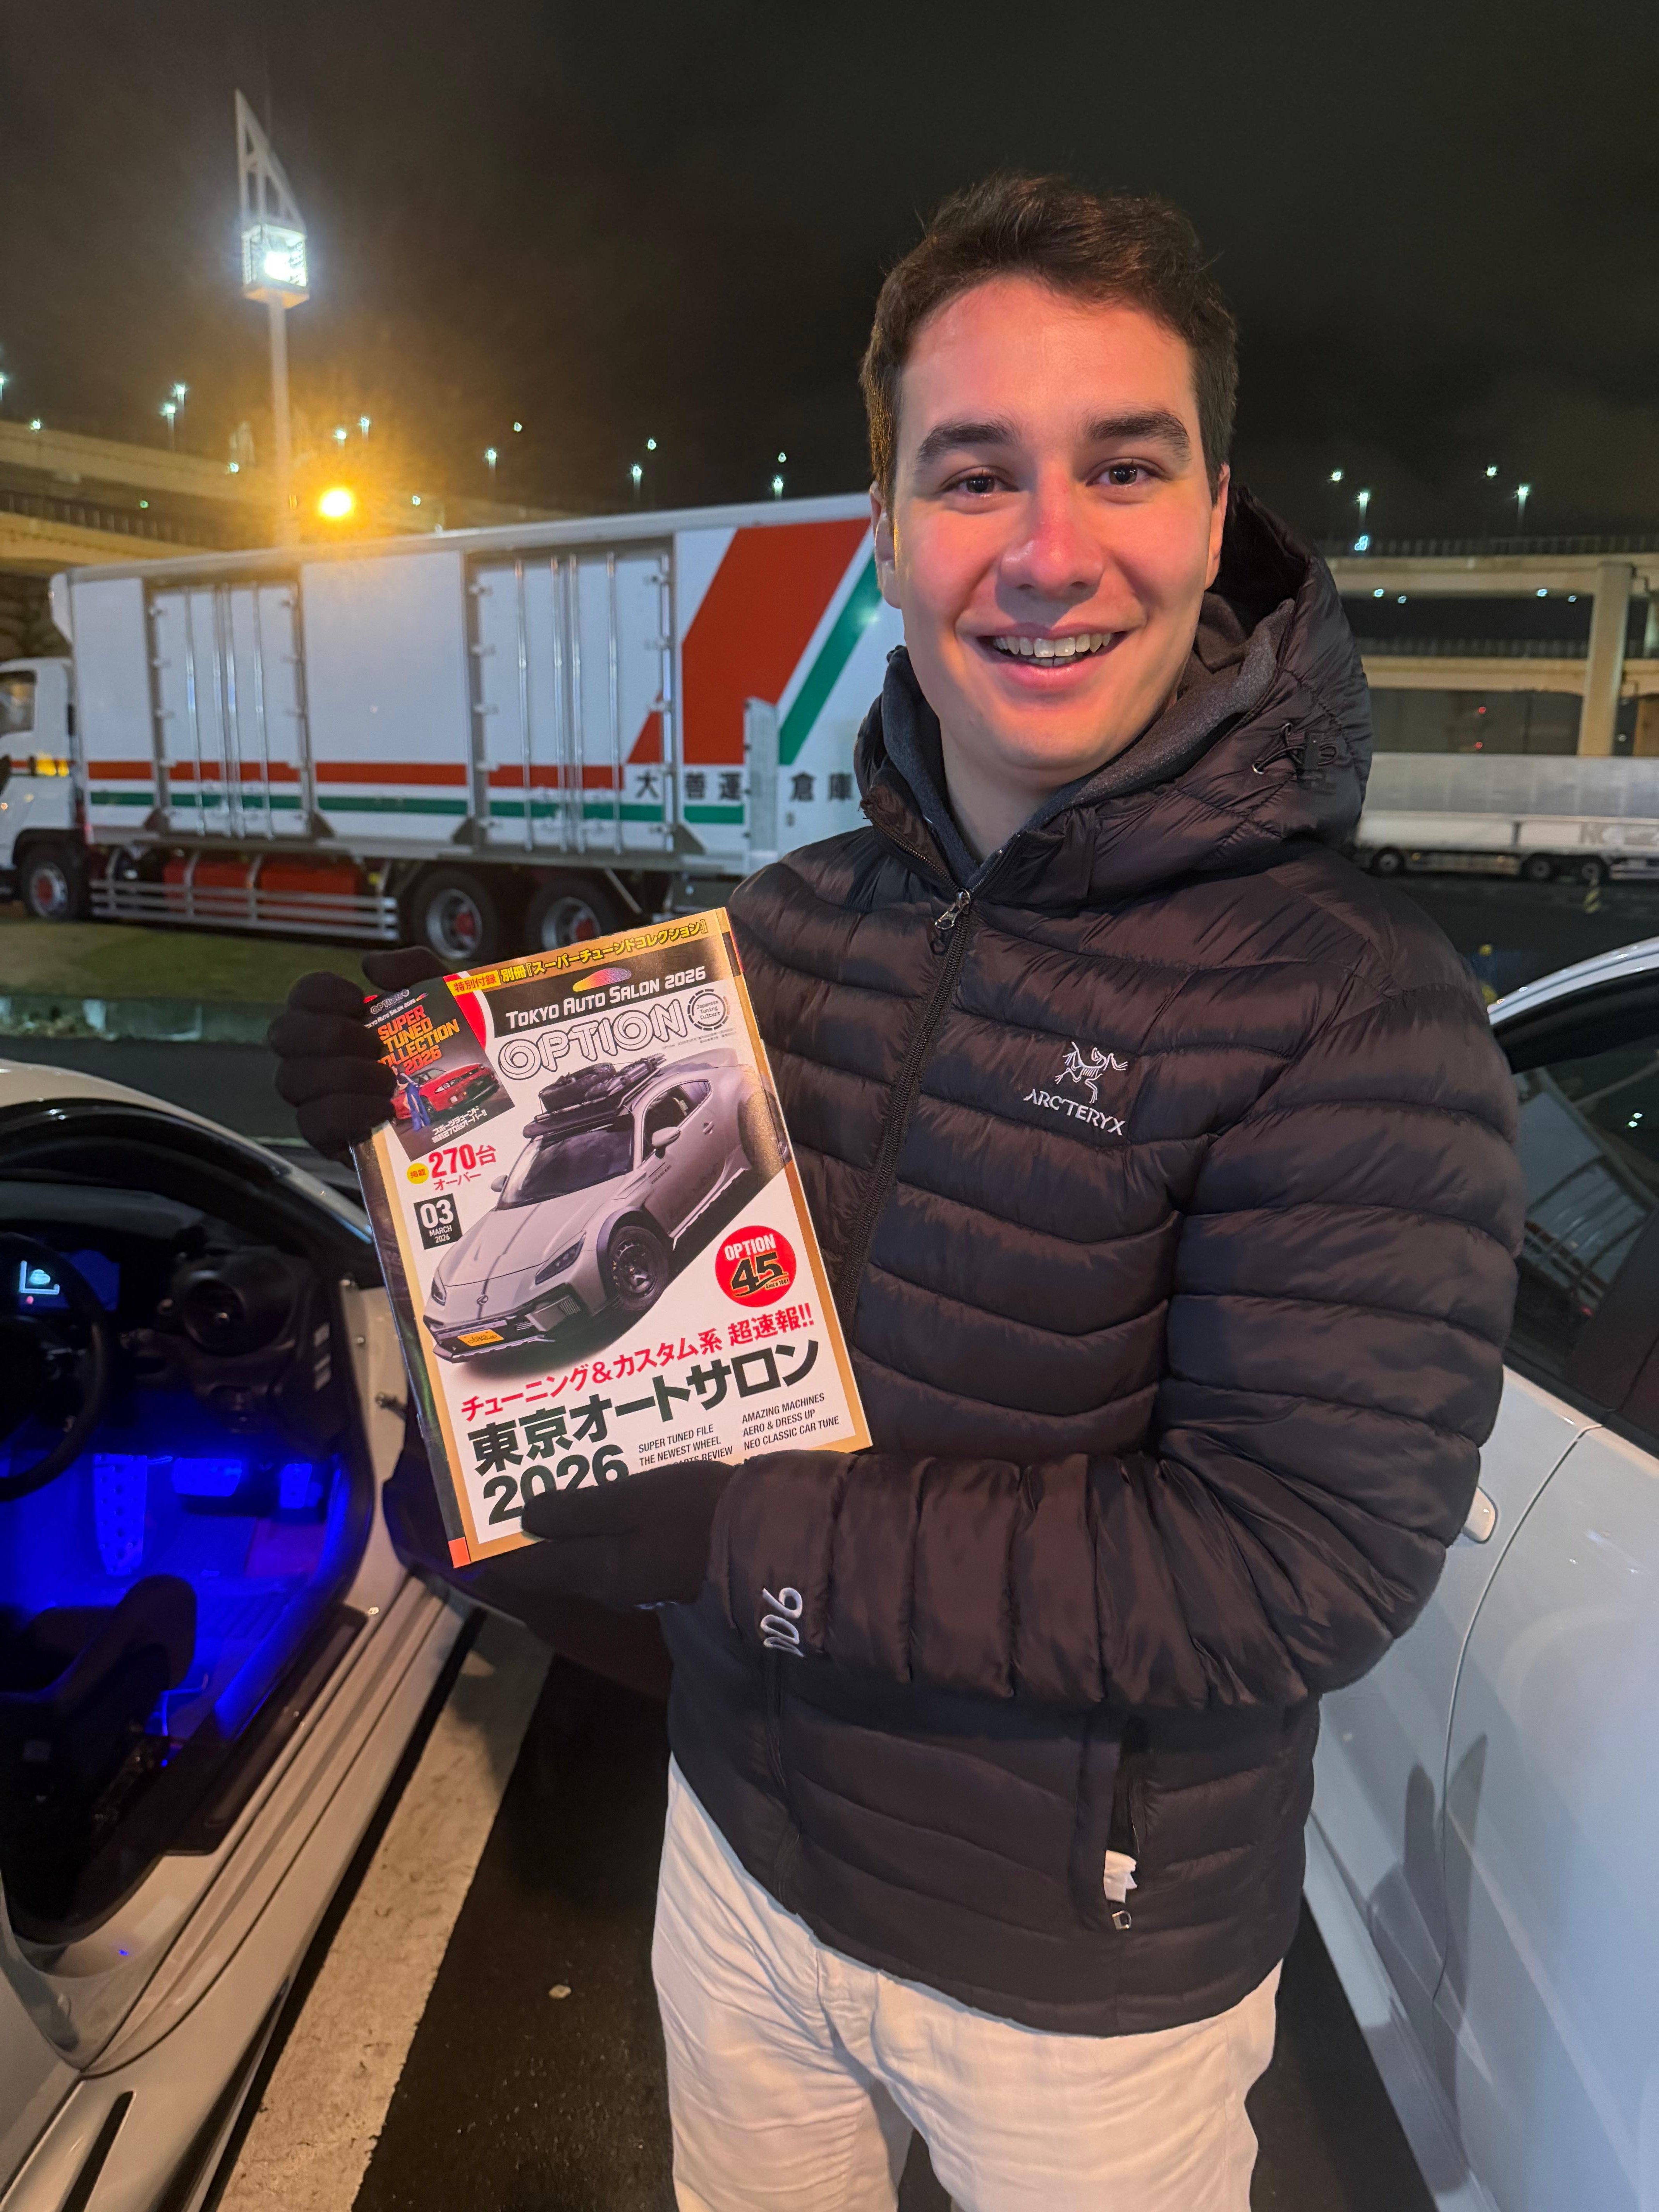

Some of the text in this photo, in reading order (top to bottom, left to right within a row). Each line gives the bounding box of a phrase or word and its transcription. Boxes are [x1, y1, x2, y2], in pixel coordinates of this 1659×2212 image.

[454, 975, 497, 992] 特別付録
[506, 966, 706, 1029] TOKYO AUTO SALON 2026
[697, 1000, 719, 1009] Japanese
[700, 1006, 718, 1014] Tuning
[700, 1011, 721, 1020] Culture
[378, 1005, 426, 1041] SUPER
[383, 1017, 433, 1052] TUNED
[377, 1018, 460, 1068] OLLECTION
[498, 999, 688, 1080] OPTION
[403, 1045, 442, 1075] 2026
[429, 1144, 496, 1178] 270台
[434, 1171, 481, 1190] オーバー
[420, 1199, 453, 1228] 03
[429, 1225, 452, 1237] MARCH
[434, 1234, 450, 1243] 2026
[724, 1233, 776, 1261] OPTION
[732, 1251, 784, 1294] 45
[461, 1303, 814, 1422] チューニング&カスタム系 超速報!!
[467, 1339, 819, 1477] 東京オートサロン
[742, 1393, 824, 1424] AMAZING MACHINES
[743, 1409, 815, 1437] AERO & DRESS UP
[639, 1424, 713, 1453] SUPER TUNED FILE
[744, 1415, 839, 1450] NEO CLASSIC CAR TUNE
[639, 1436, 721, 1466] THE NEWEST WHEEL
[702, 1446, 732, 1461] REVIEW
[483, 1444, 629, 1525] 2026
